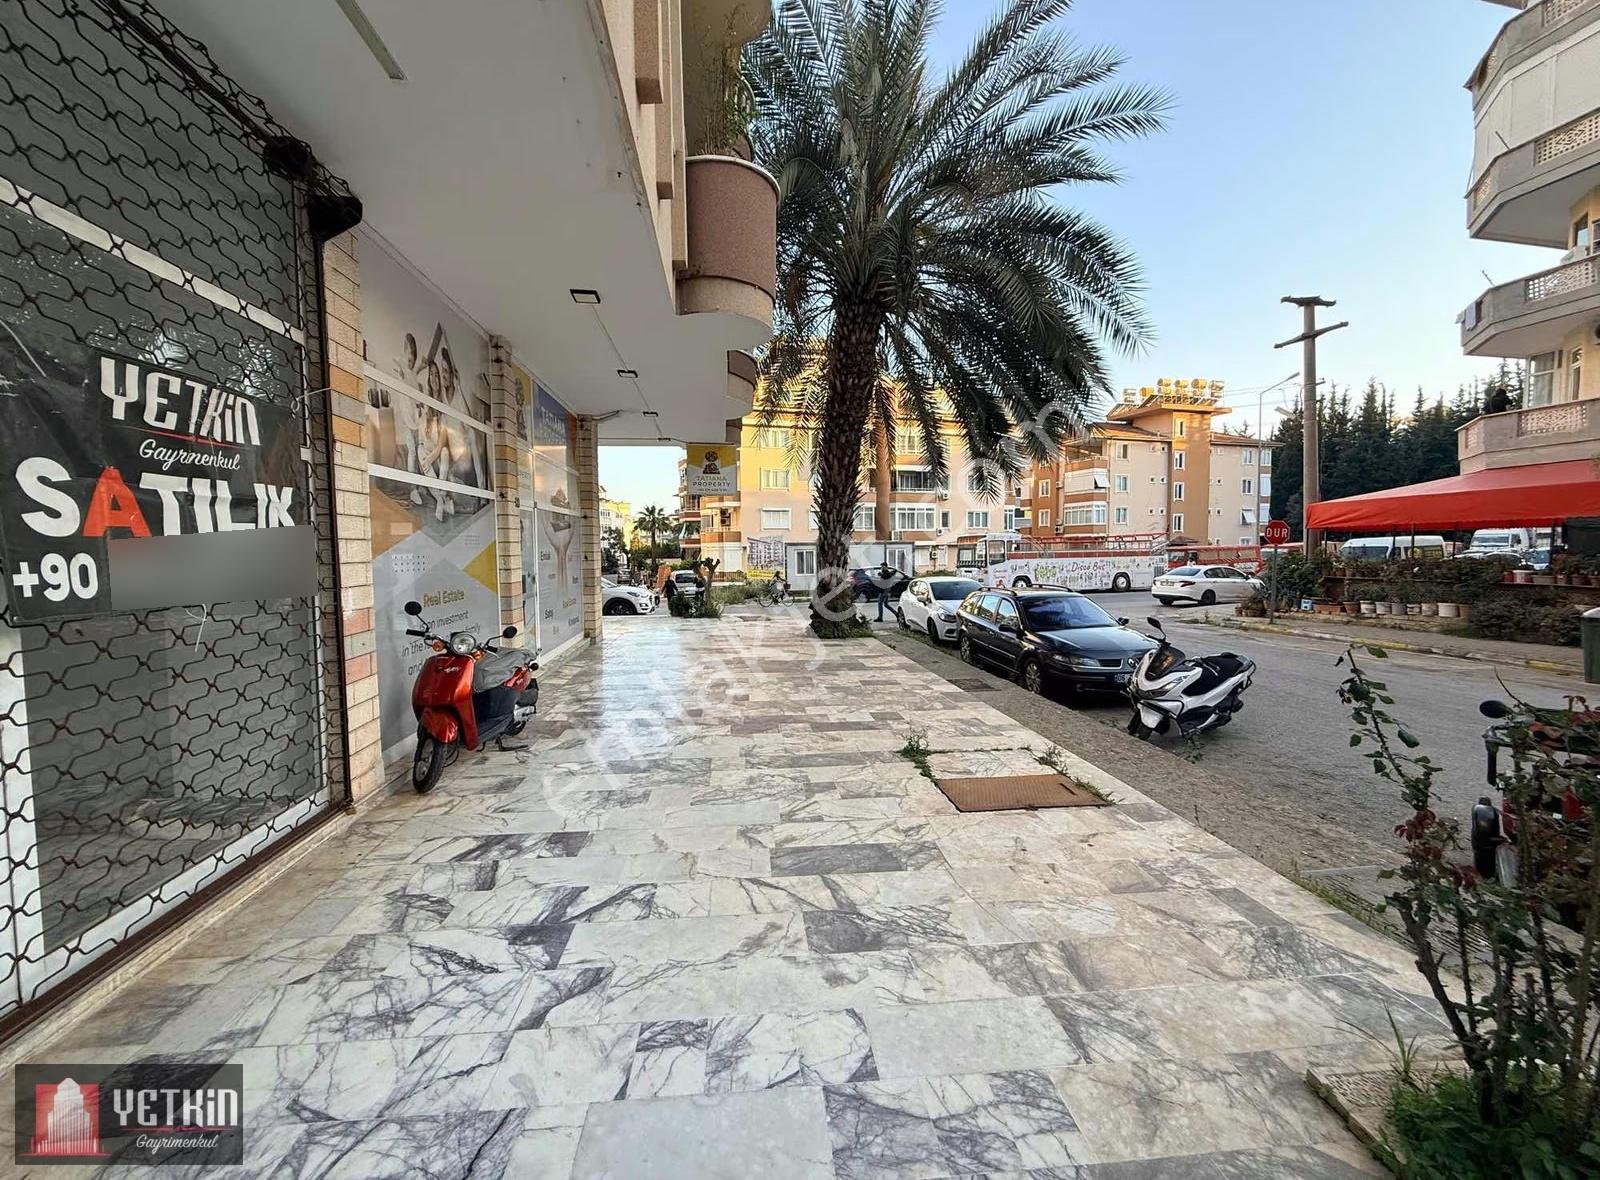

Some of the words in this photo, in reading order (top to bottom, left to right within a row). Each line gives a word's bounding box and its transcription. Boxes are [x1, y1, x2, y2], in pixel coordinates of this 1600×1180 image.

[15, 456, 296, 538] SATILIK
[1266, 527, 1288, 538] DUR
[1071, 561, 1090, 573] Disco
[1093, 560, 1106, 572] Bus
[13, 552, 99, 602] +90
[423, 591, 441, 607] Real
[442, 589, 465, 604] Estate
[437, 610, 469, 627] investment
